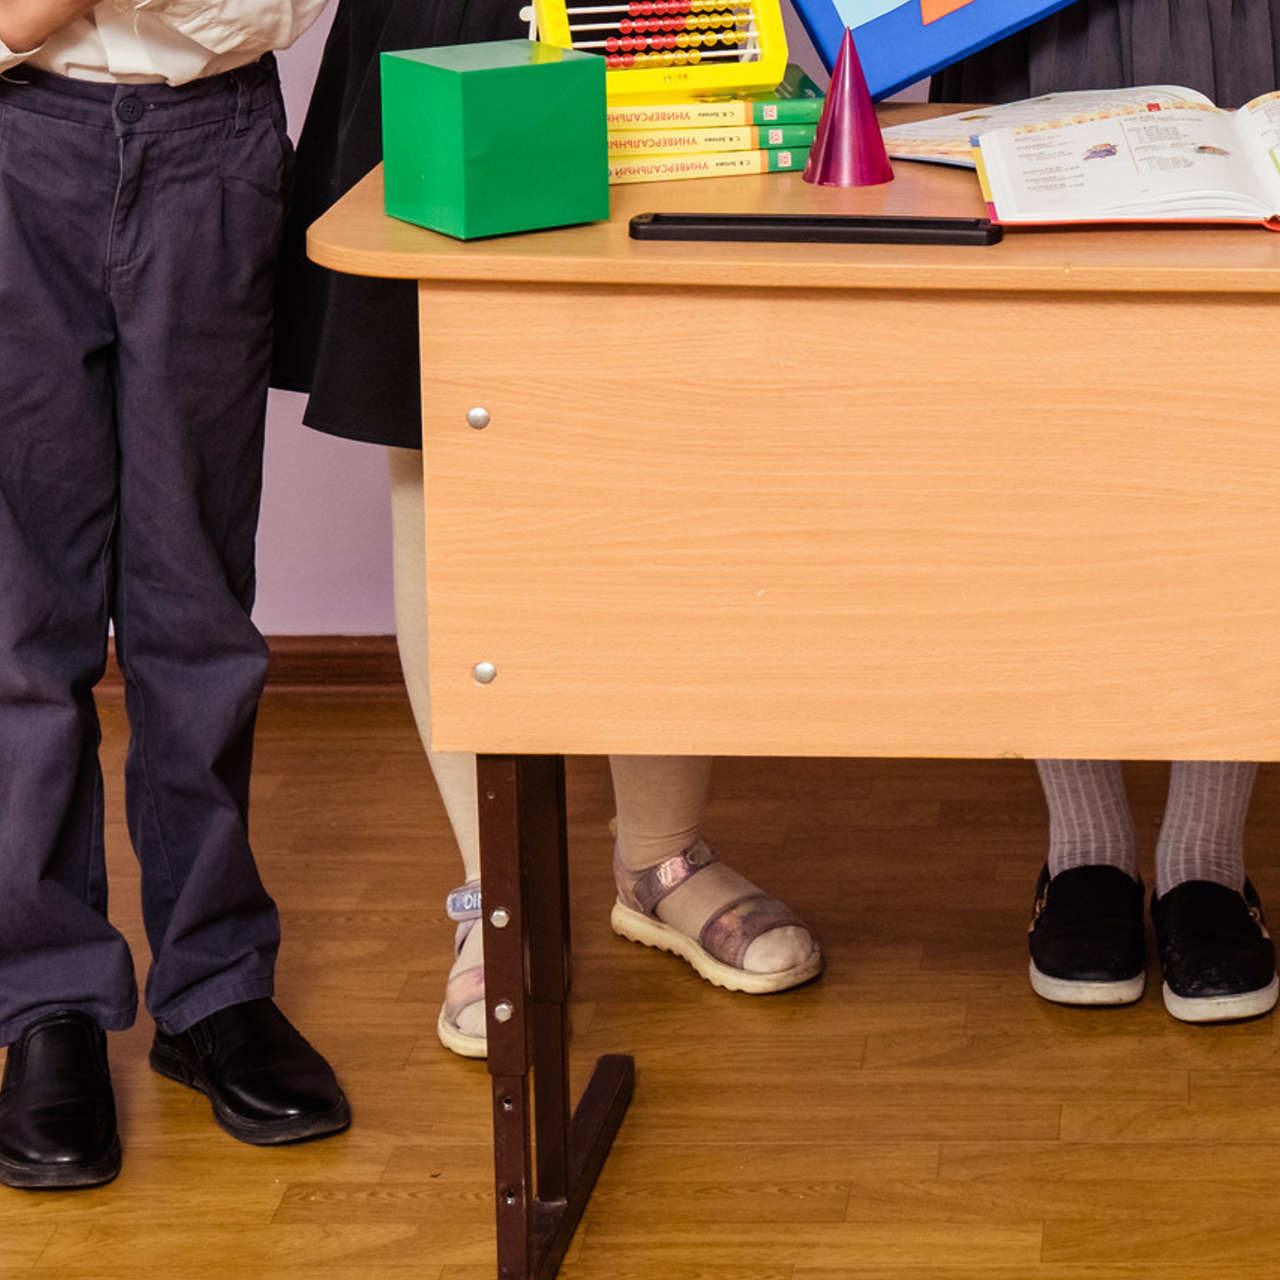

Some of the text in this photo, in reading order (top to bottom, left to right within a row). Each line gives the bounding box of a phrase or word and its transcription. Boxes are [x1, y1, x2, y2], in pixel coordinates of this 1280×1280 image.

[607, 111, 691, 123] УНИВЕРСАЛЬН
[609, 136, 697, 149] УНИВЕРСАЛЬНЫ
[614, 162, 709, 178] УНИВЕРСАЛЬНЫЙ
